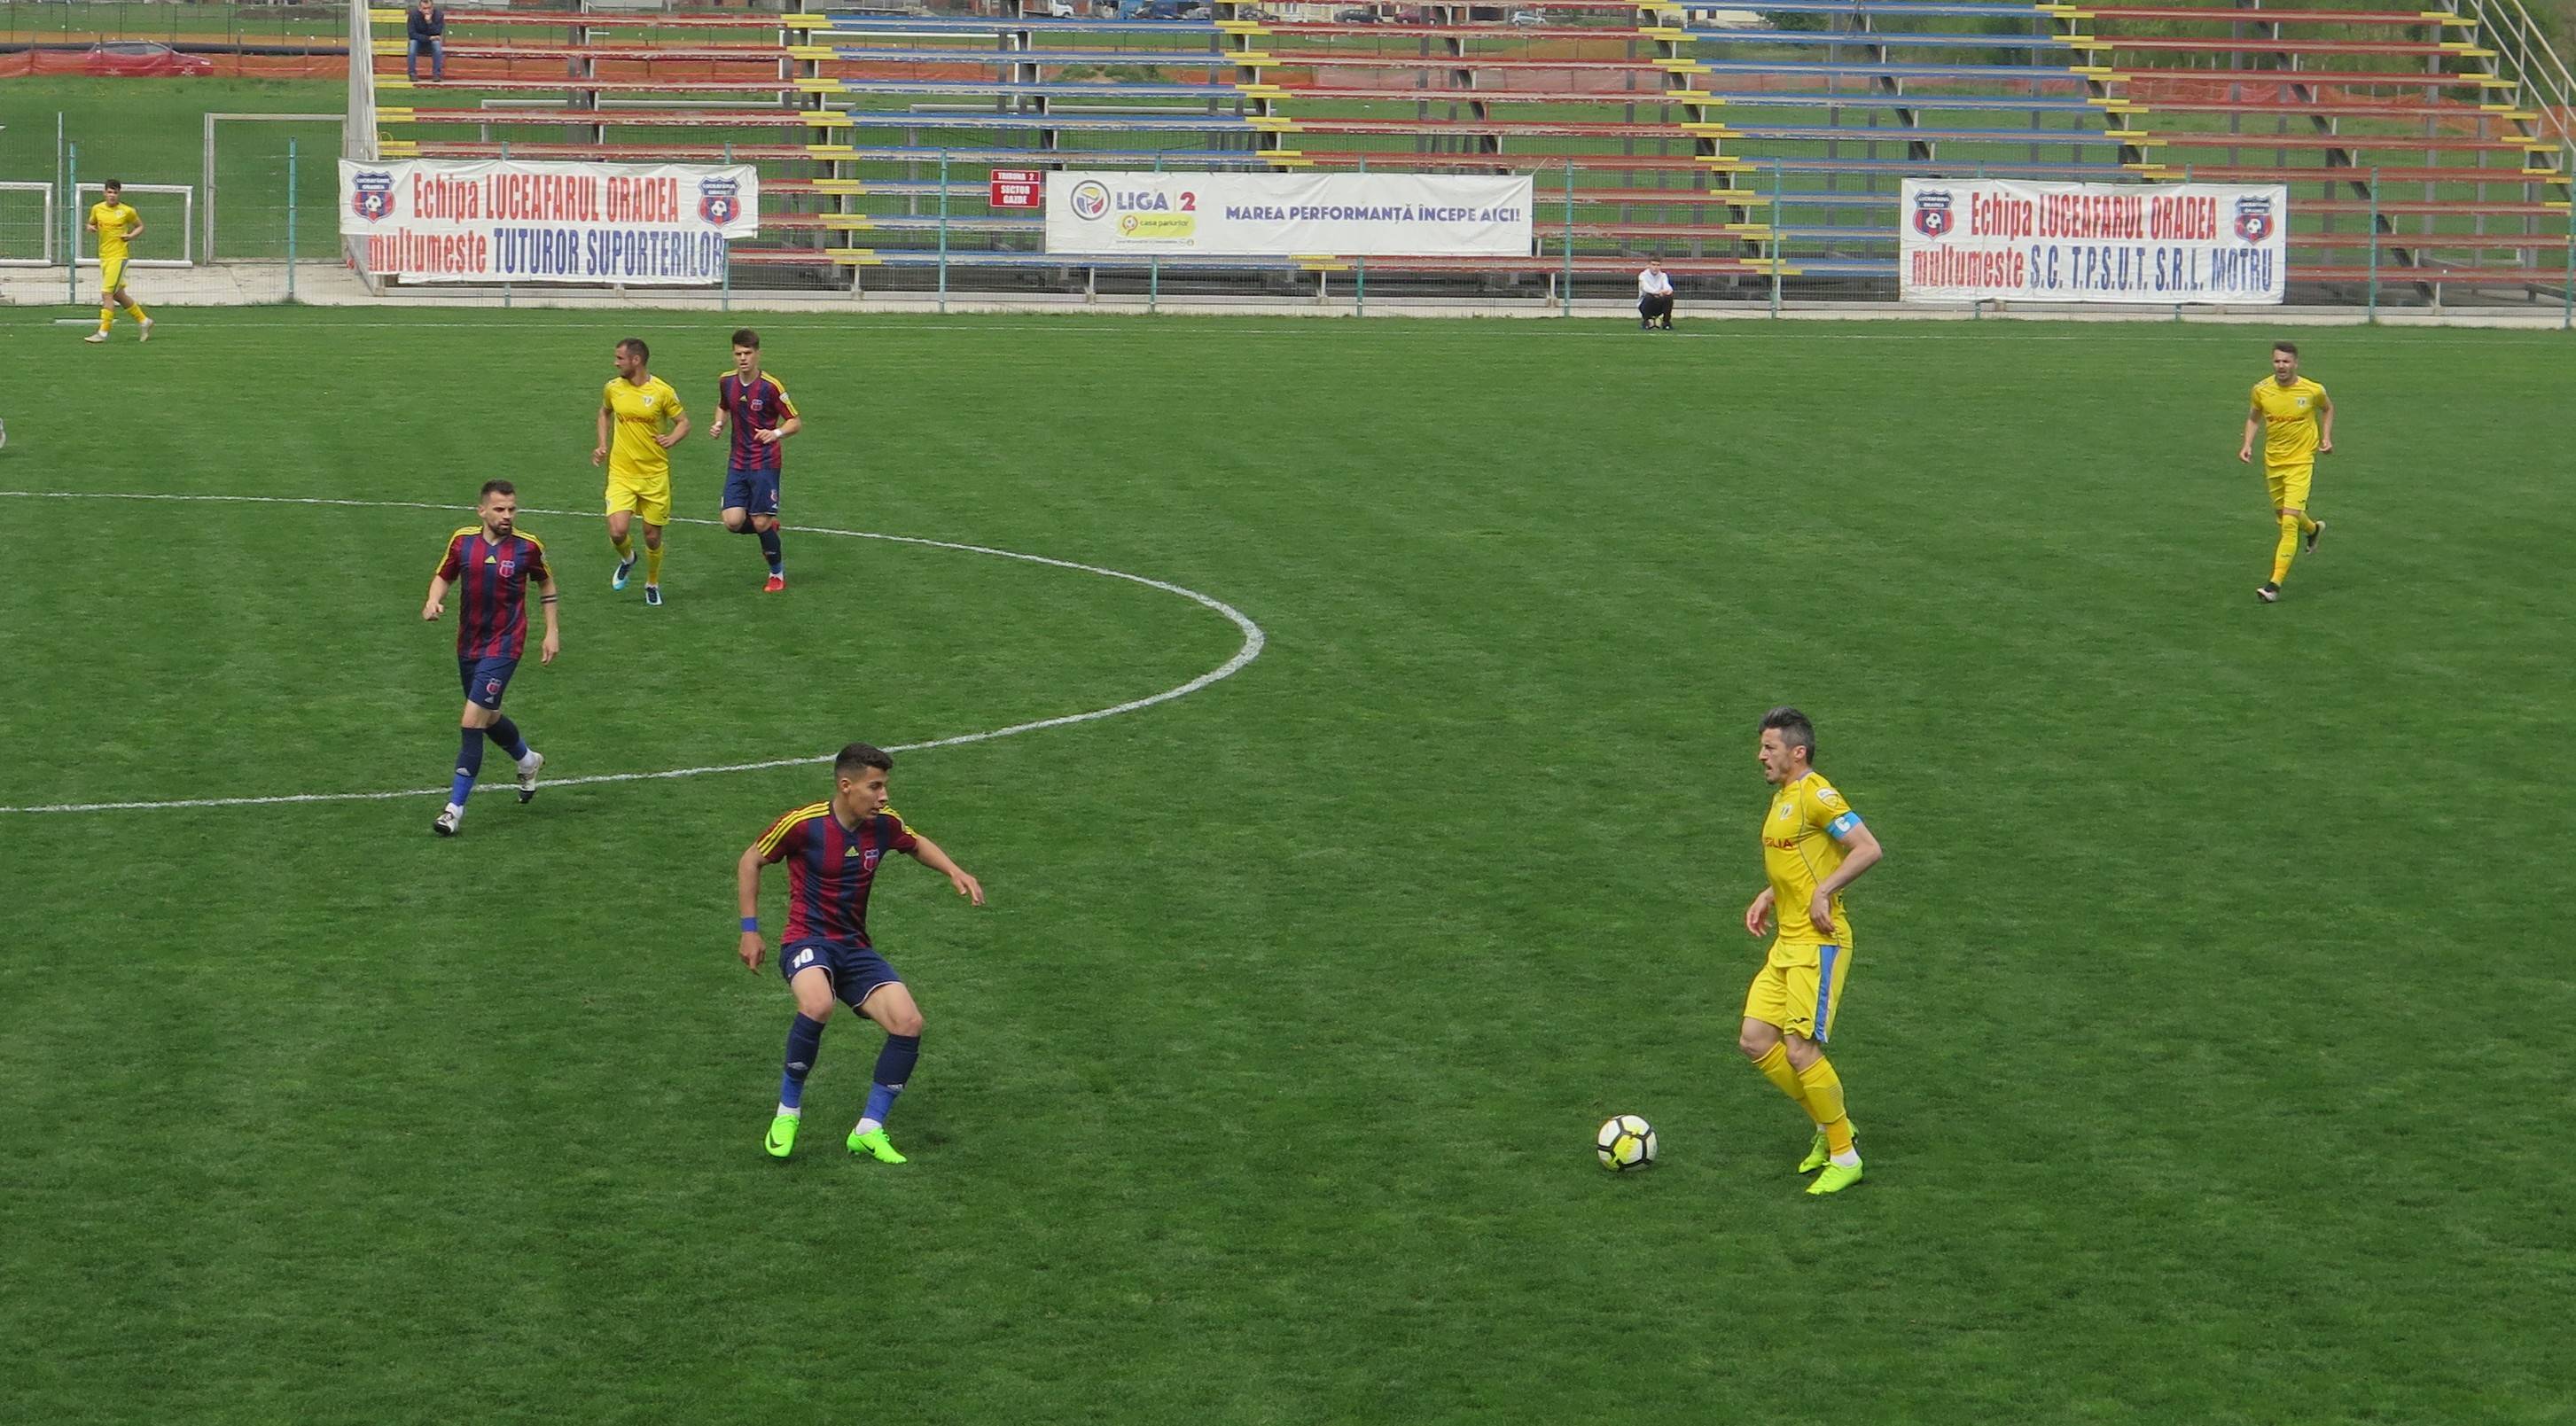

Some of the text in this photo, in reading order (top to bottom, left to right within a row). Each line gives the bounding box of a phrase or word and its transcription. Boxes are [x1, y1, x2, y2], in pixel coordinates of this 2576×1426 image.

[413, 173, 679, 223] Echipa LUCEAFARUL ORADEA
[1000, 184, 1031, 195] SECTOR
[1116, 191, 1197, 211] LIGA 2
[1225, 206, 1285, 221] MAREA
[1418, 204, 1476, 222] ÎNCEPE
[1479, 207, 1520, 222] AICI!
[1971, 191, 2217, 241] Echipa LUCEAFARUL ORADEA
[369, 226, 724, 278] multumeste TUTUROR SUPORTERILOR
[1912, 244, 2024, 289] multumeste
[2030, 244, 2063, 289] S.C.
[2155, 246, 2204, 292] S.R.L.
[2211, 247, 2273, 292] MOTRU
[792, 947, 815, 969] 10
